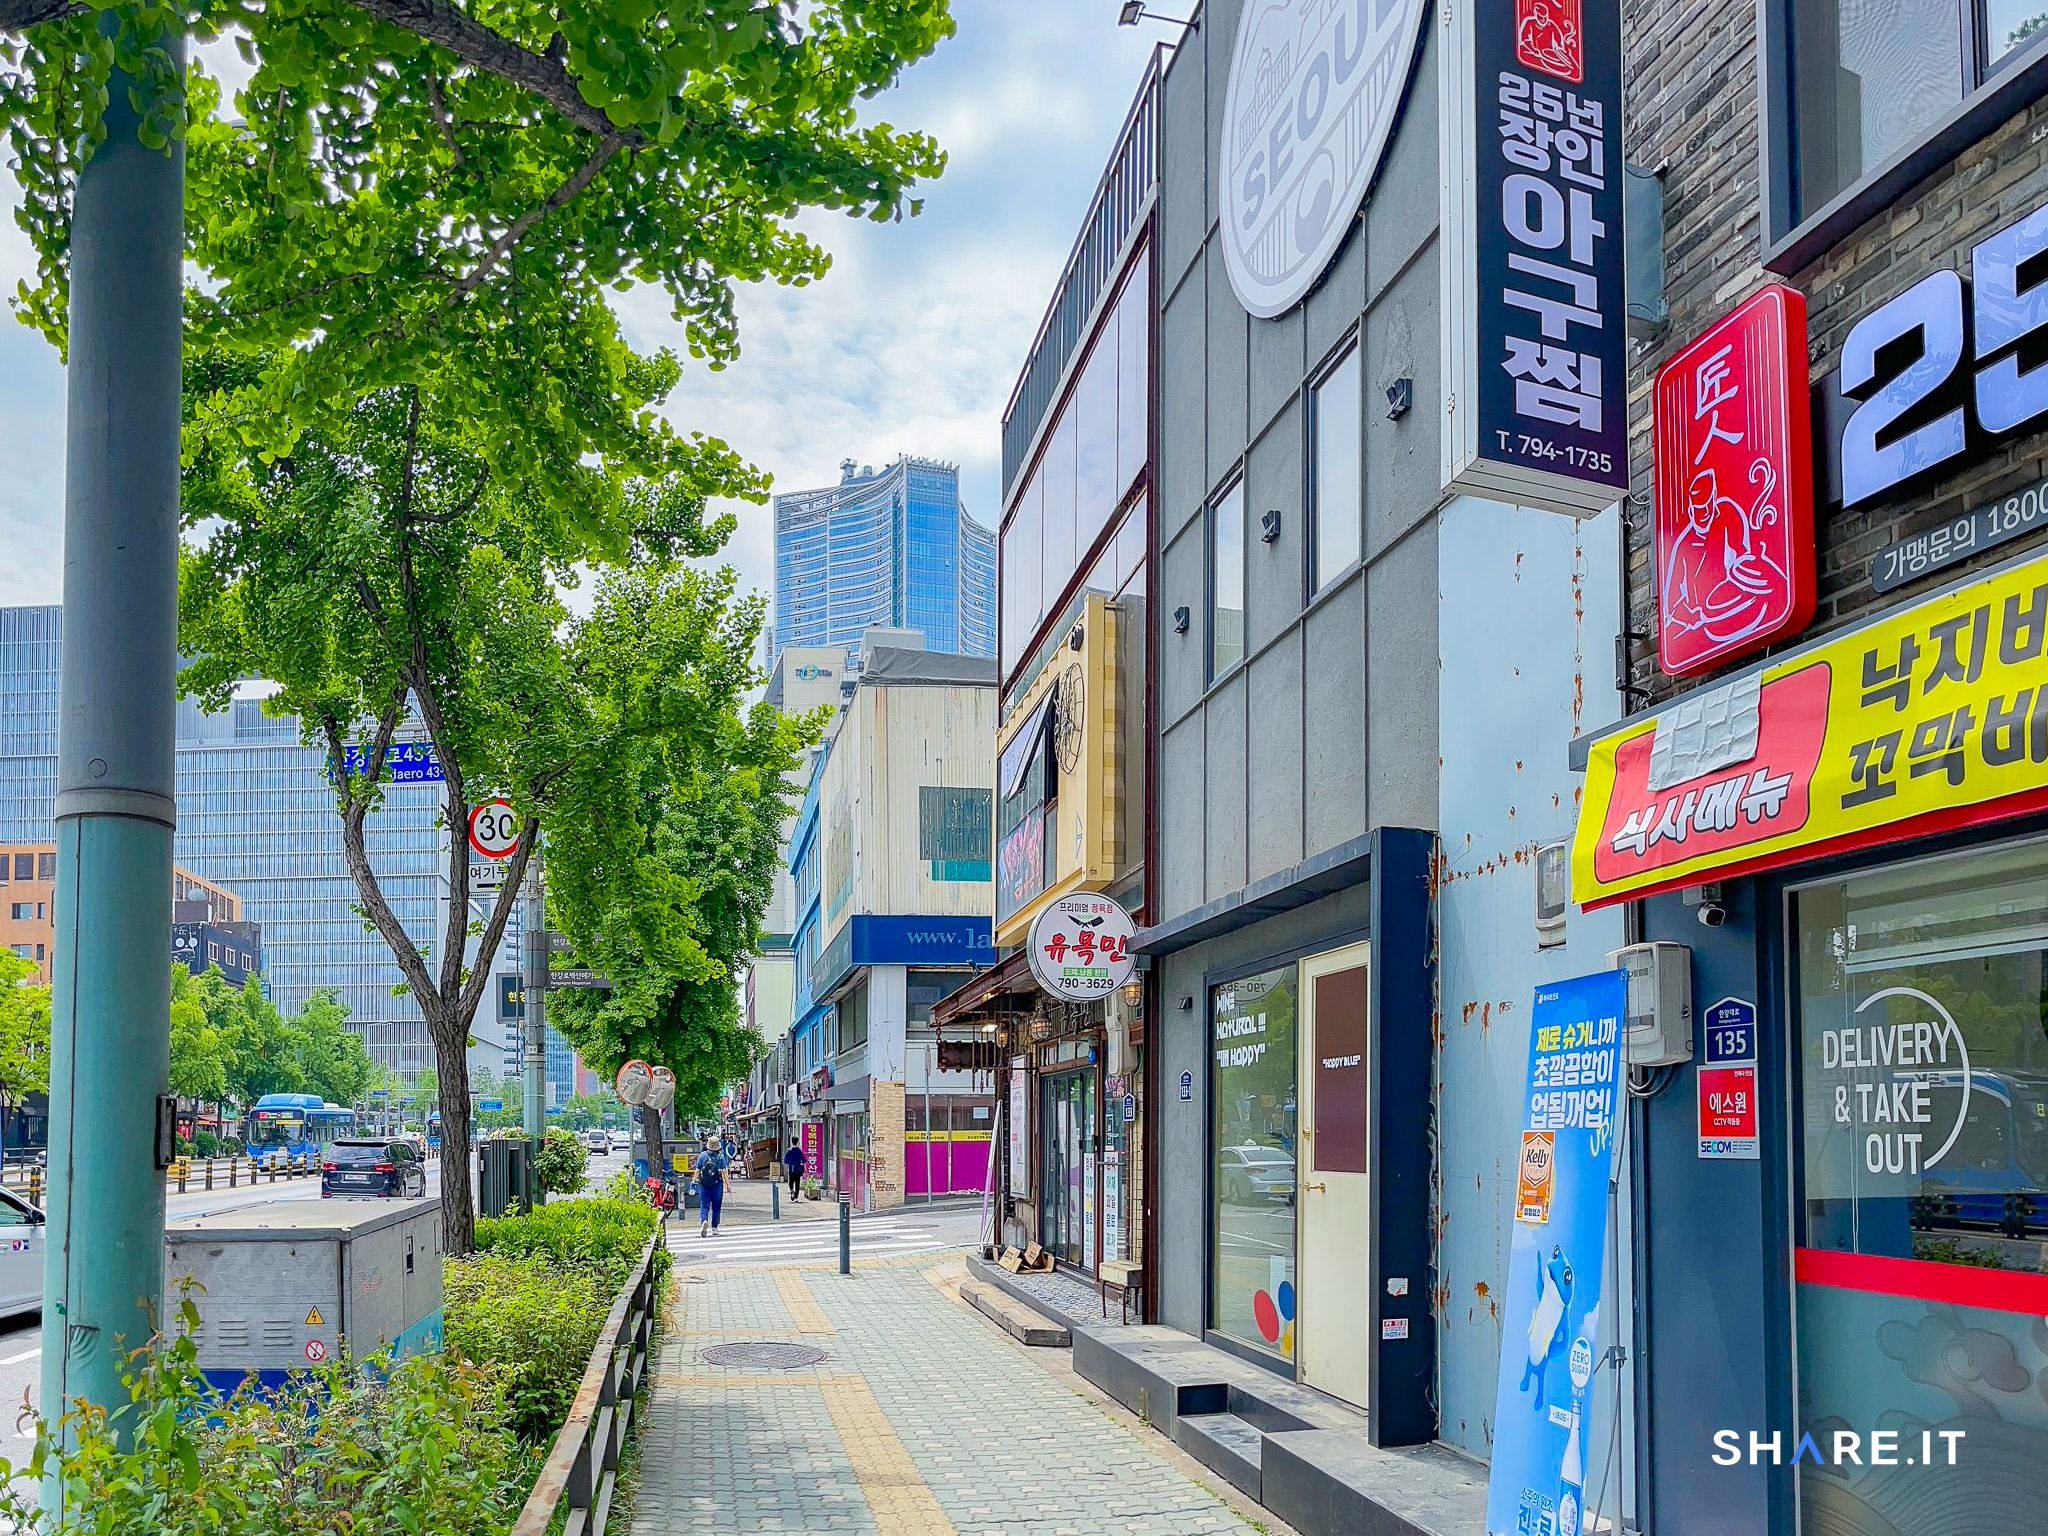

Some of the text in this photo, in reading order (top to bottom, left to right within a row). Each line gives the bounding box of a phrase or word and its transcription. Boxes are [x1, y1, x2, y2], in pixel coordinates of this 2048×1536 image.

[1499, 71, 1604, 138] 25년
[1498, 108, 1605, 191] 장인
[1499, 173, 1606, 434] 아구찜
[1694, 343, 1745, 466] 匠人
[1496, 429, 1613, 474] T. 794-1735
[1883, 515, 1977, 583] 가맹문의
[479, 814, 515, 841] 30
[1611, 765, 1793, 857] 식사메뉴
[1059, 902, 1113, 914] 프리미엄 정육점
[906, 928, 992, 949] www.la
[1044, 930, 1128, 967] 유목민
[1057, 977, 1114, 989] 790-3629
[1719, 1008, 1740, 1018] 한강대로
[1535, 1016, 1618, 1052] 제로 슈거니까
[1715, 1029, 1747, 1055] 135
[1822, 1021, 1953, 1070] DELIVERY
[1532, 1048, 1615, 1088] 초깔끔함이
[1709, 1091, 1747, 1115] 에스원
[1834, 1081, 1932, 1123] & TAKE
[1525, 1148, 1550, 1168] Kelly
[1701, 1141, 1731, 1154] SECOM
[1865, 1133, 1923, 1175] OUT
[1571, 1362, 1589, 1377] SUGAR
[1572, 1350, 1590, 1364] ZERO
[1520, 1487, 1540, 1507] 소주의
